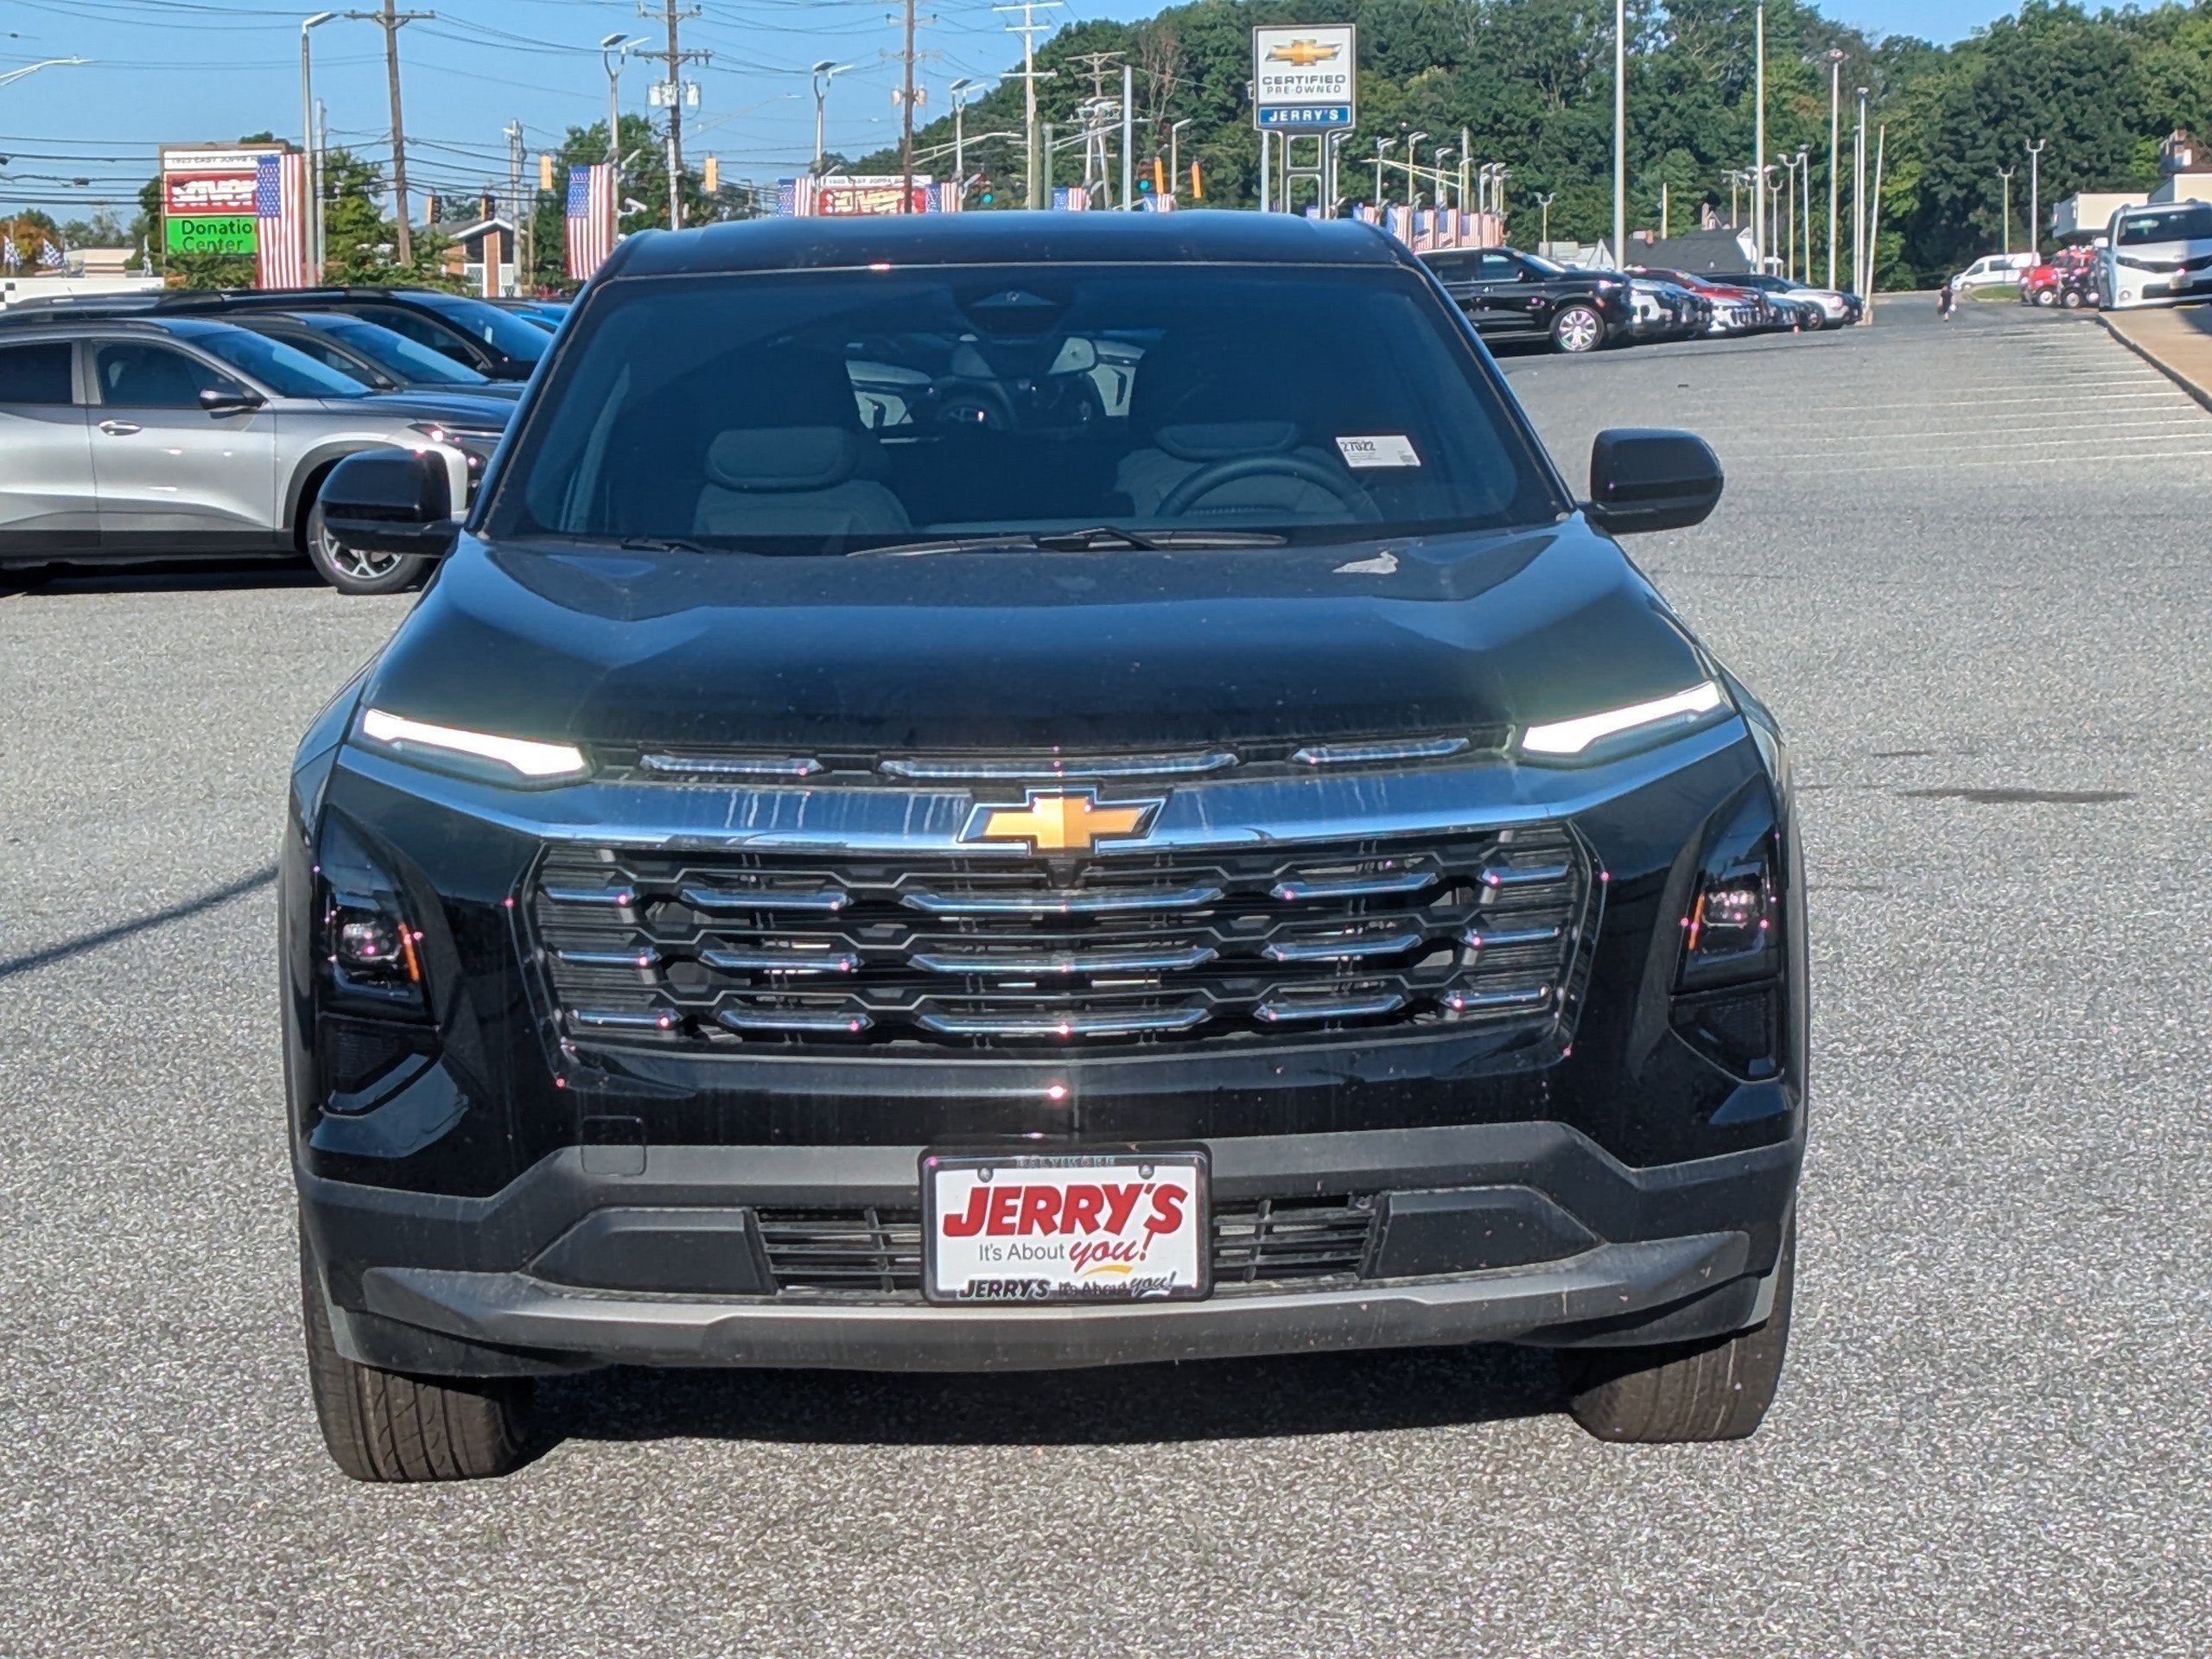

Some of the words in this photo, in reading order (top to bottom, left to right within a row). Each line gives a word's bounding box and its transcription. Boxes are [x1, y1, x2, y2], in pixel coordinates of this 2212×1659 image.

[1262, 74, 1346, 86] CERTIFIED
[1266, 84, 1341, 95] PRE-OWNED
[1268, 109, 1339, 122] JERRY'S
[181, 219, 255, 236] Donatio
[182, 236, 245, 251] Center
[943, 1183, 1189, 1237] JERRY'S
[979, 1243, 1002, 1262] It's
[1007, 1243, 1065, 1262] About
[1069, 1230, 1154, 1274] you!
[958, 1278, 1052, 1298] JERRY'S
[1129, 1270, 1177, 1298] you!
